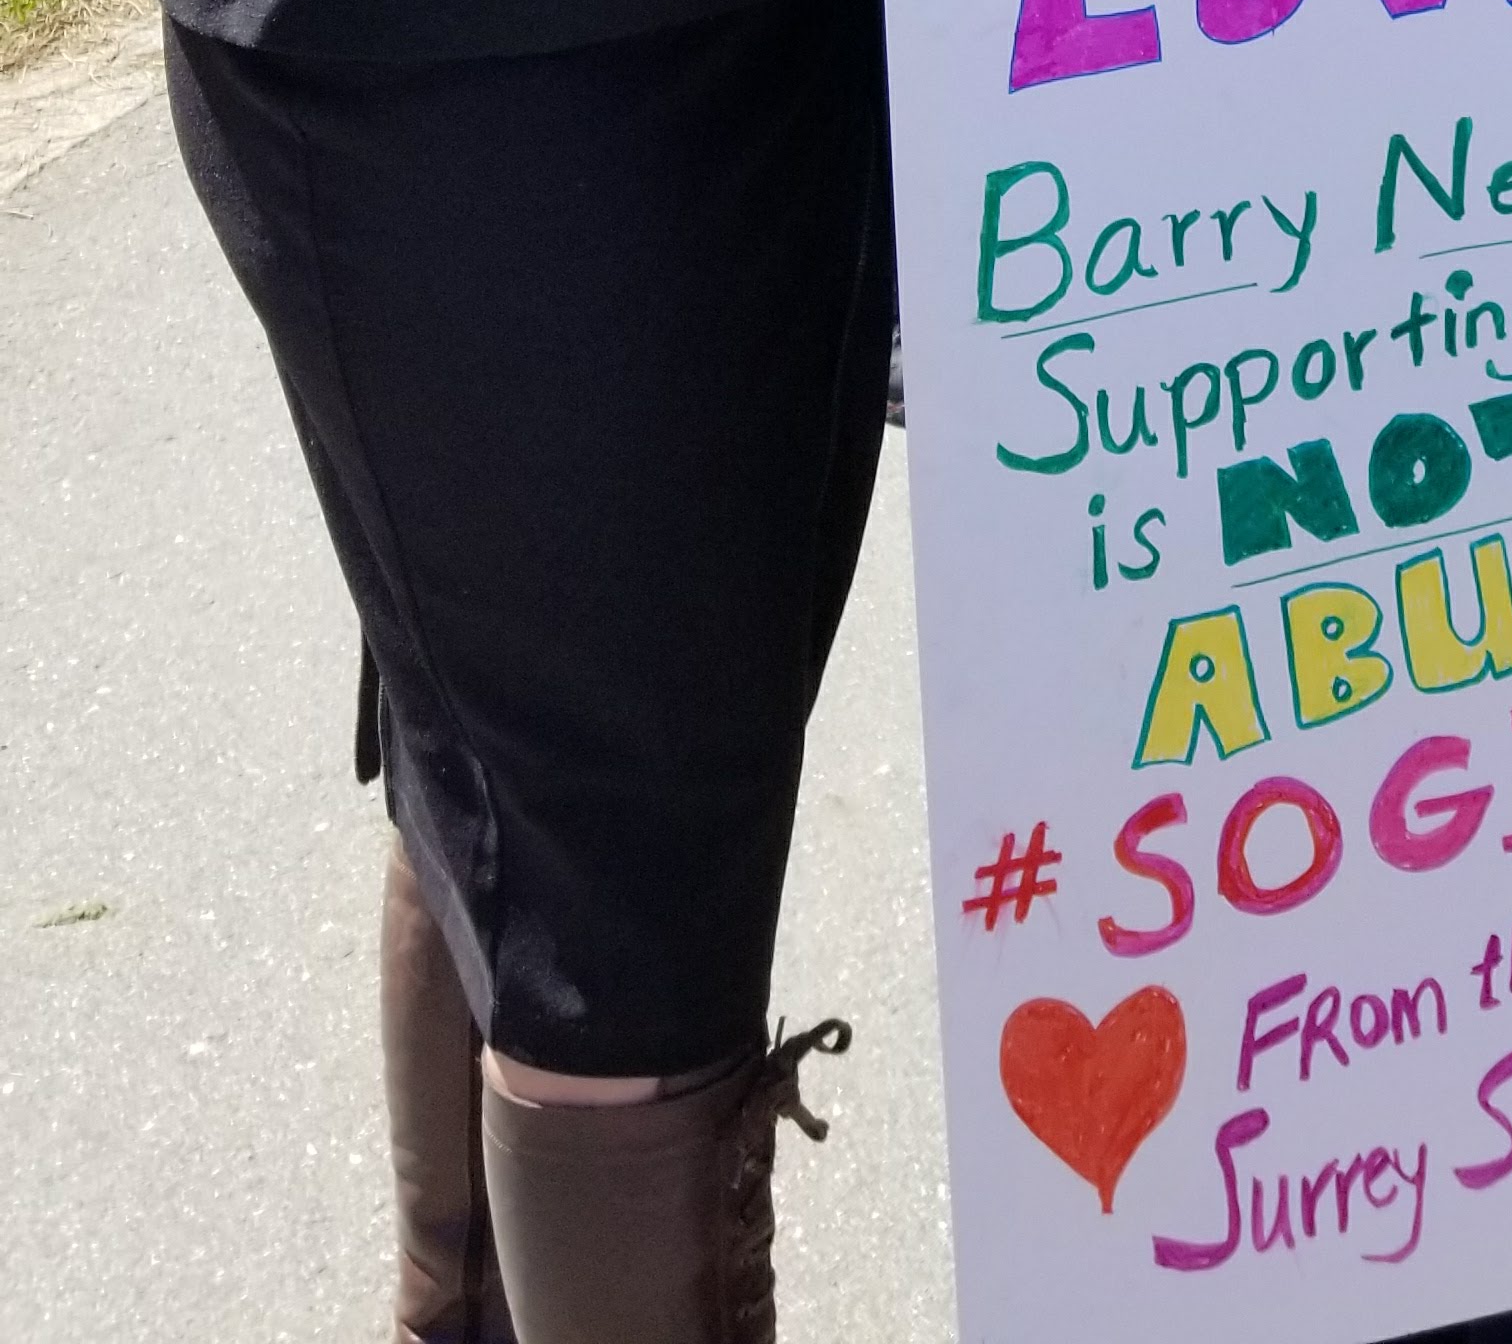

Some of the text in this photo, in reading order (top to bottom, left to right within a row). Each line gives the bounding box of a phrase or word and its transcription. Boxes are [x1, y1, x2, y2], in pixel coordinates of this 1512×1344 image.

[976, 161, 1317, 323] Barry
[1088, 493, 1167, 591] is
[1153, 1108, 1428, 1271] Surrey
